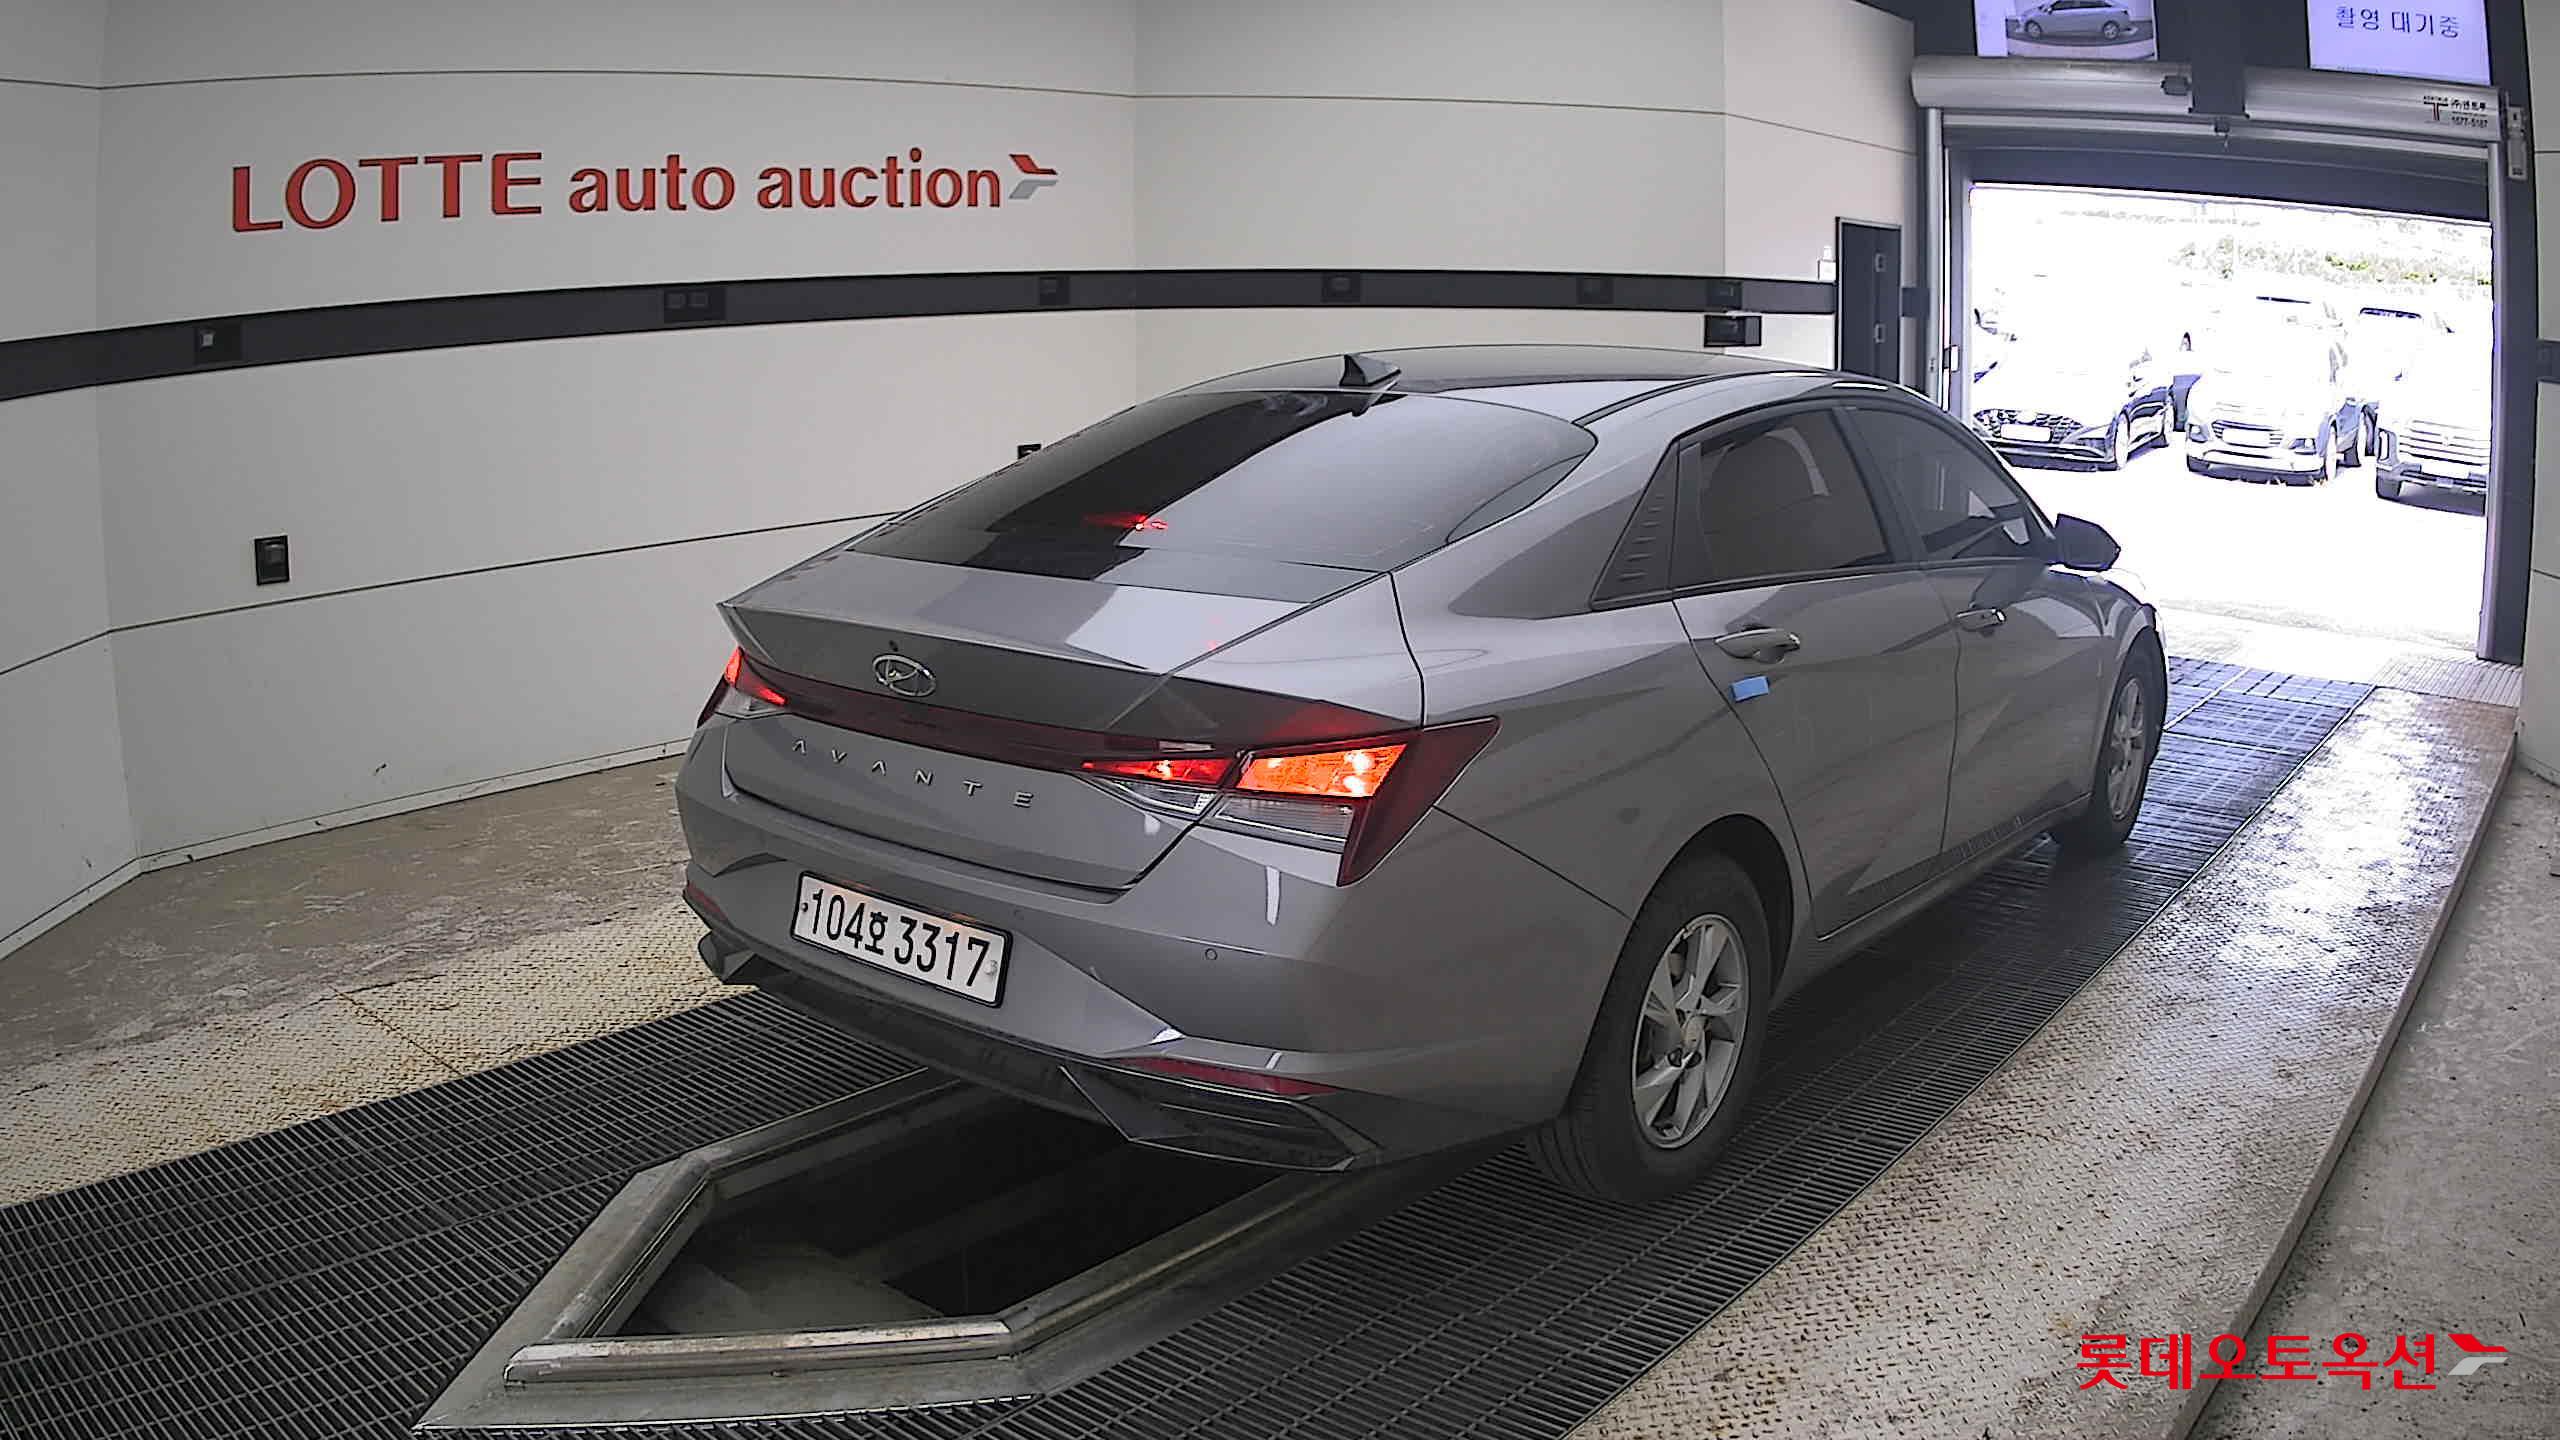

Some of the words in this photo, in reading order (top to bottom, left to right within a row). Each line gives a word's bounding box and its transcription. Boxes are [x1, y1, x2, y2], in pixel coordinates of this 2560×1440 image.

[2336, 6, 2381, 31] 촬영
[2391, 11, 2459, 38] 대기중
[232, 152, 542, 232] LOTTE
[569, 153, 736, 213] auto
[757, 147, 1001, 208] auction
[792, 738, 1034, 809] AVANTE
